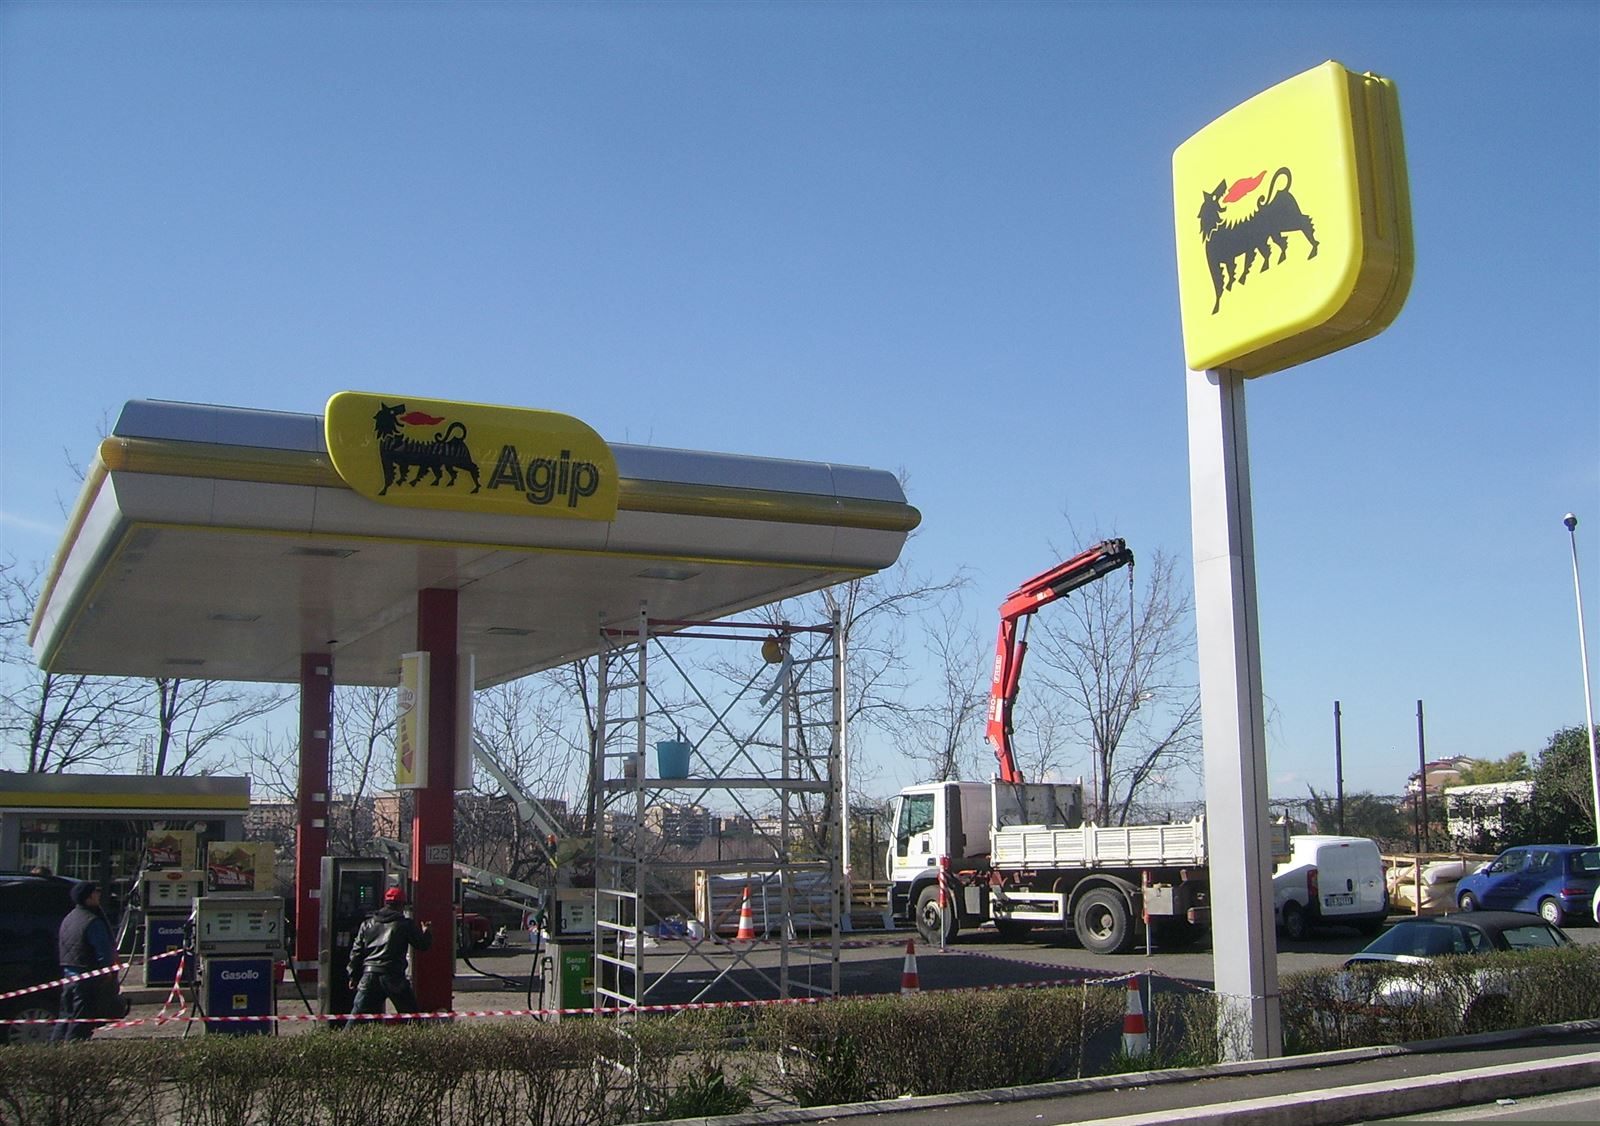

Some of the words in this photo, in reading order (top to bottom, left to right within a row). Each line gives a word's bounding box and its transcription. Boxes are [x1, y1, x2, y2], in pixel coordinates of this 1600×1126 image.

[487, 445, 600, 508] Agip
[429, 847, 448, 859] 125
[205, 922, 211, 934] 1
[268, 922, 276, 933] 2
[566, 957, 586, 965] Senza
[221, 970, 259, 980] Gasolio
